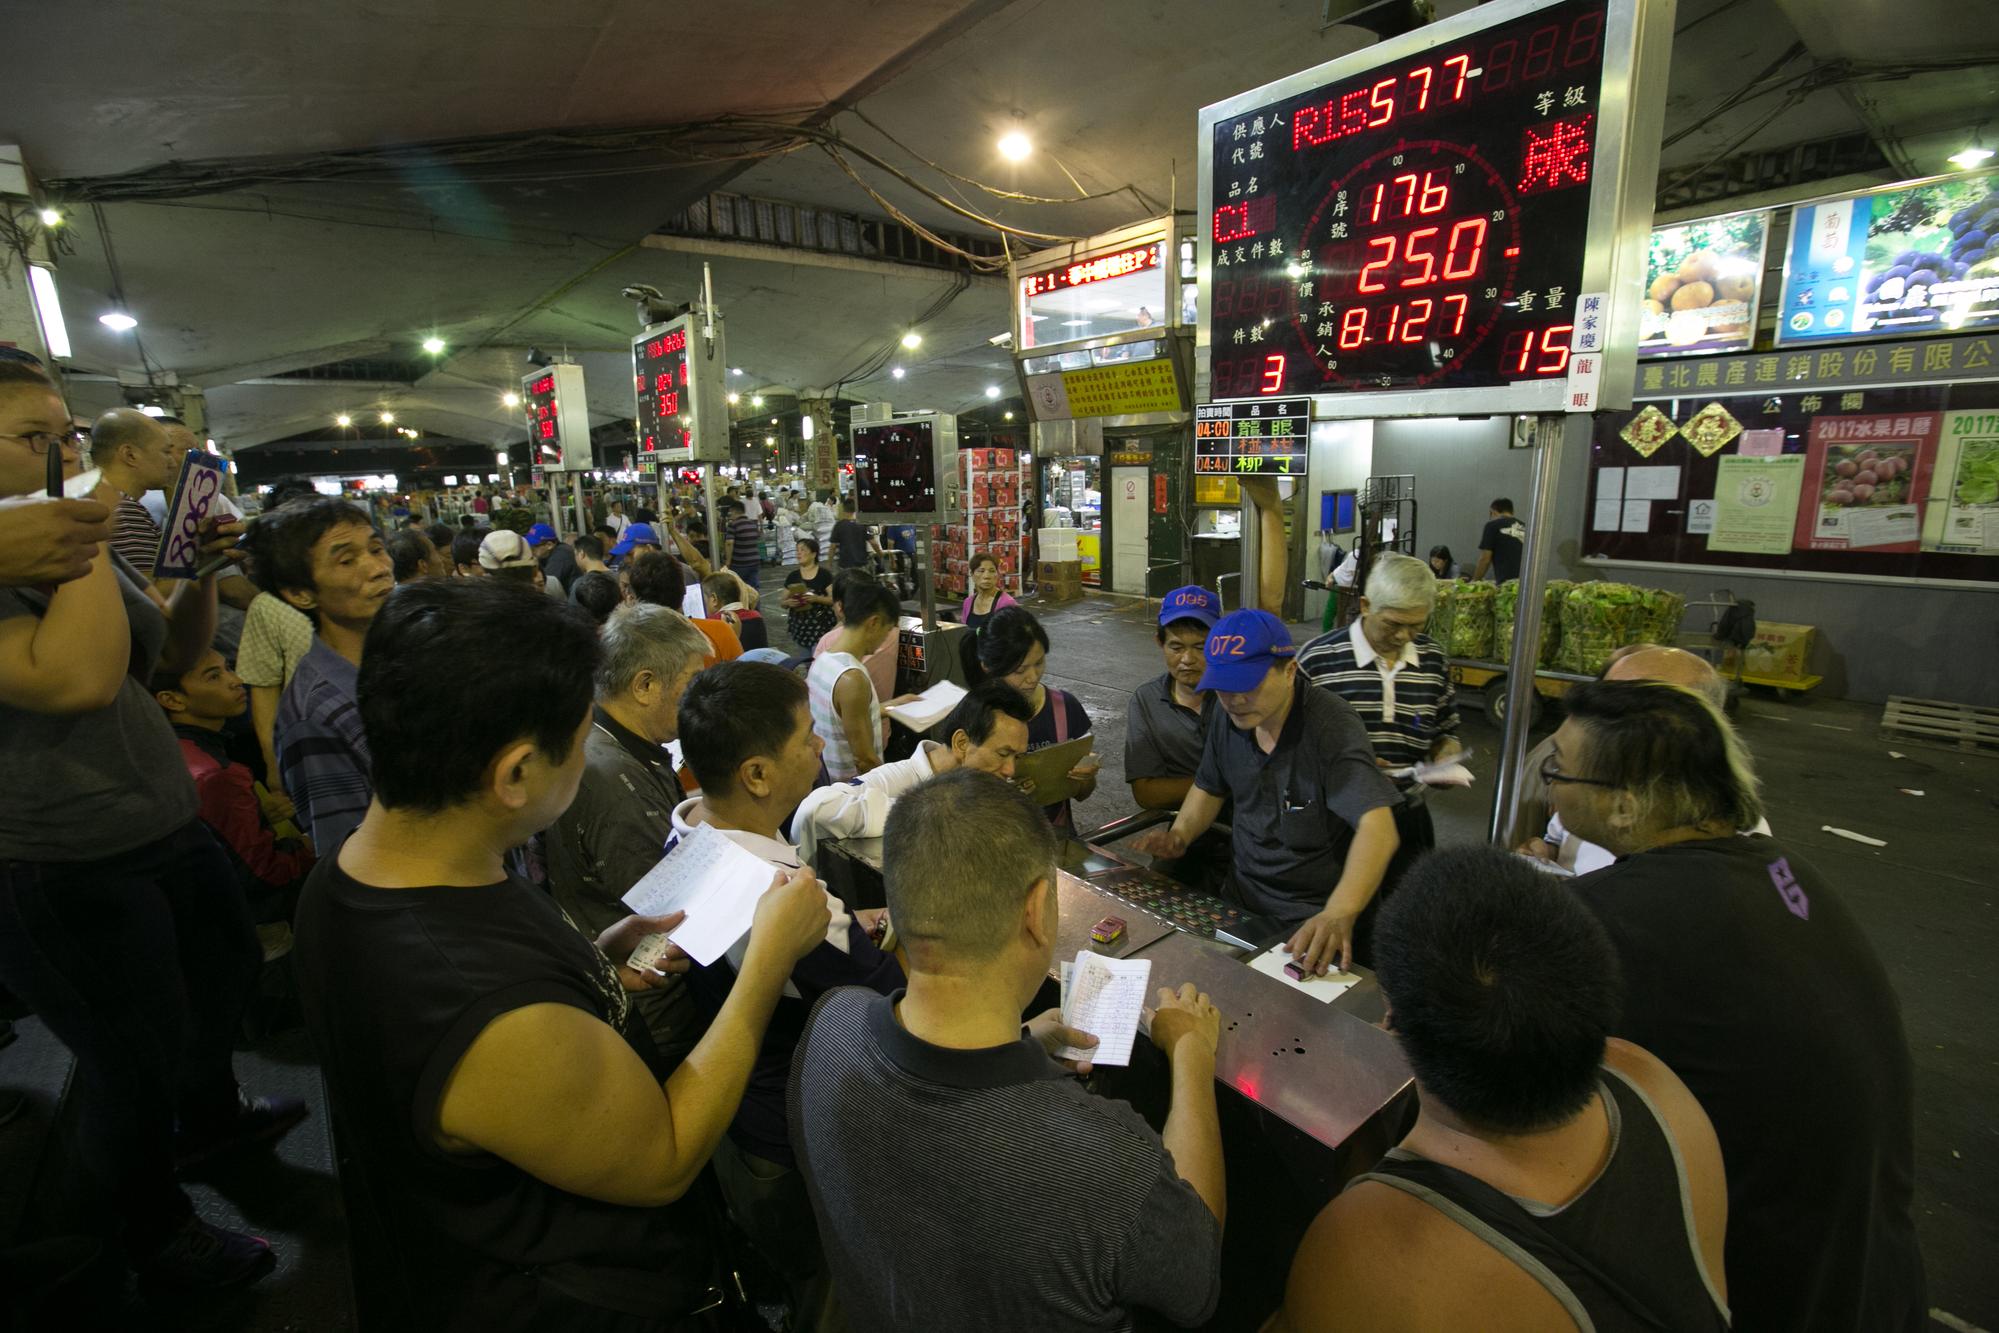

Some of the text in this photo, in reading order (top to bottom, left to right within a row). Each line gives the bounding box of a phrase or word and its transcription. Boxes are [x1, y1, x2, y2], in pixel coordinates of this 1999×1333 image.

[1534, 86, 1587, 115] 等級
[1233, 112, 1285, 141] 供應人
[1231, 141, 1264, 164] 代號
[1393, 155, 1403, 166] 00
[1455, 163, 1465, 174] 10
[1228, 176, 1259, 198] 品名
[1337, 190, 1347, 200] 90
[1372, 172, 1448, 222] 176
[1331, 200, 1349, 239] 序號
[1492, 210, 1504, 221] 20
[1823, 211, 1841, 249] 葡萄
[1216, 238, 1284, 266] 成交件數
[1301, 249, 1311, 259] 80
[1359, 217, 1487, 293] 25.0
[1485, 287, 1497, 298] 30
[1516, 286, 1566, 313] 重量
[1300, 314, 1308, 322] 70
[1316, 301, 1335, 356] 承銷人
[1233, 325, 1264, 344] 件數
[1443, 348, 1454, 358] 40
[1518, 325, 1573, 372] 15
[1261, 354, 1285, 393] 3
[1327, 360, 1337, 369] 60
[1643, 340, 1993, 391] 臺北農產運銷股份有限公
[1381, 376, 1391, 386] 50
[1572, 359, 1592, 407] 龍眼
[1198, 406, 1231, 418] 拍賣時間
[1251, 404, 1287, 416] 品名
[1763, 392, 1865, 414] 公佈欄
[1237, 419, 1295, 437] 龍眼
[1818, 416, 1933, 439] 2017水果月曆
[1235, 456, 1293, 473] 柳丁
[1210, 635, 1246, 657] 072
